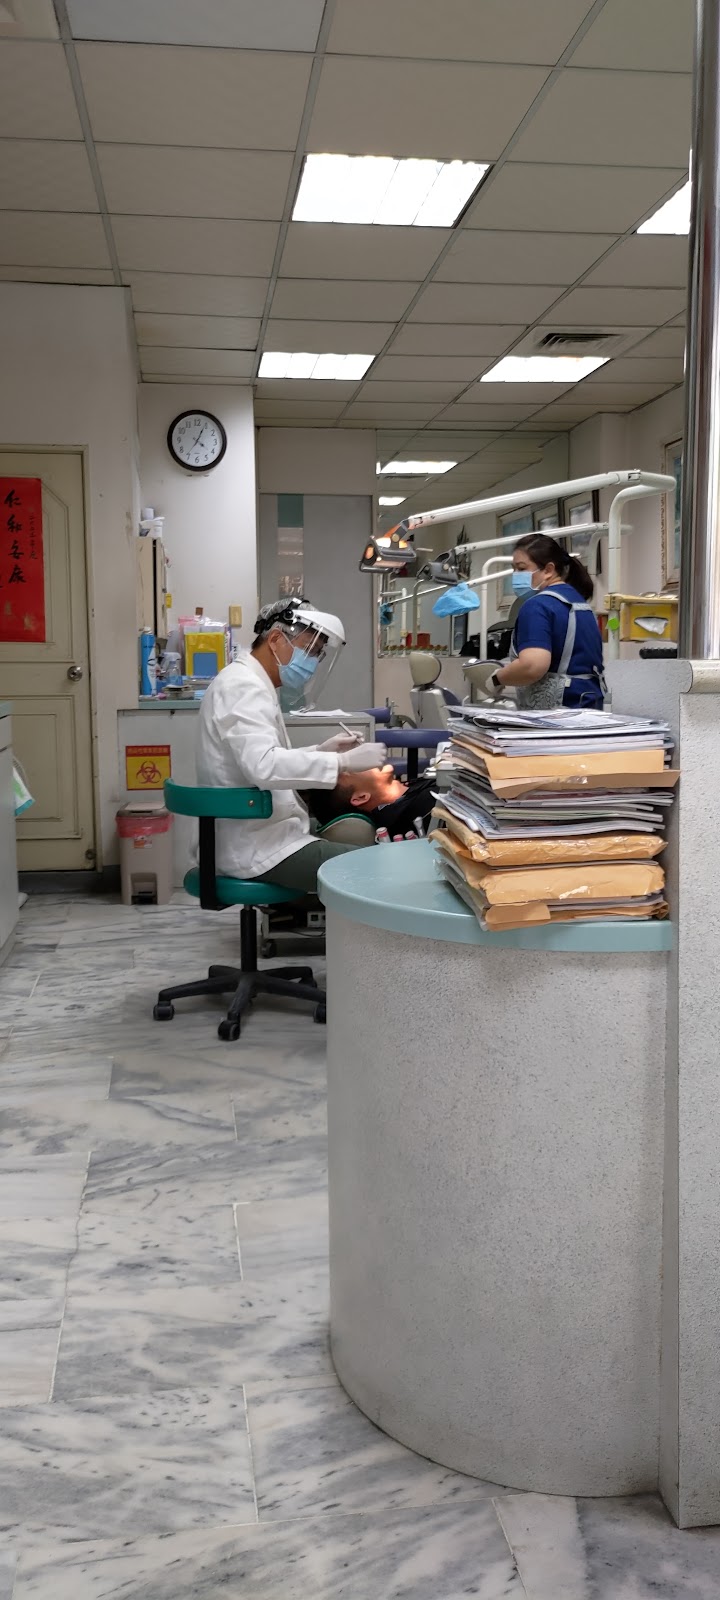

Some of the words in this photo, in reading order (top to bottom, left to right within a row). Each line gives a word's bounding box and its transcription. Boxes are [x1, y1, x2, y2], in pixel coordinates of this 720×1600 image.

[193, 418, 201, 427] 12
[210, 429, 216, 437] 2
[176, 436, 182, 444] 9
[179, 446, 184, 454] 8
[194, 455, 200, 463] 6
[204, 454, 209, 462] 5
